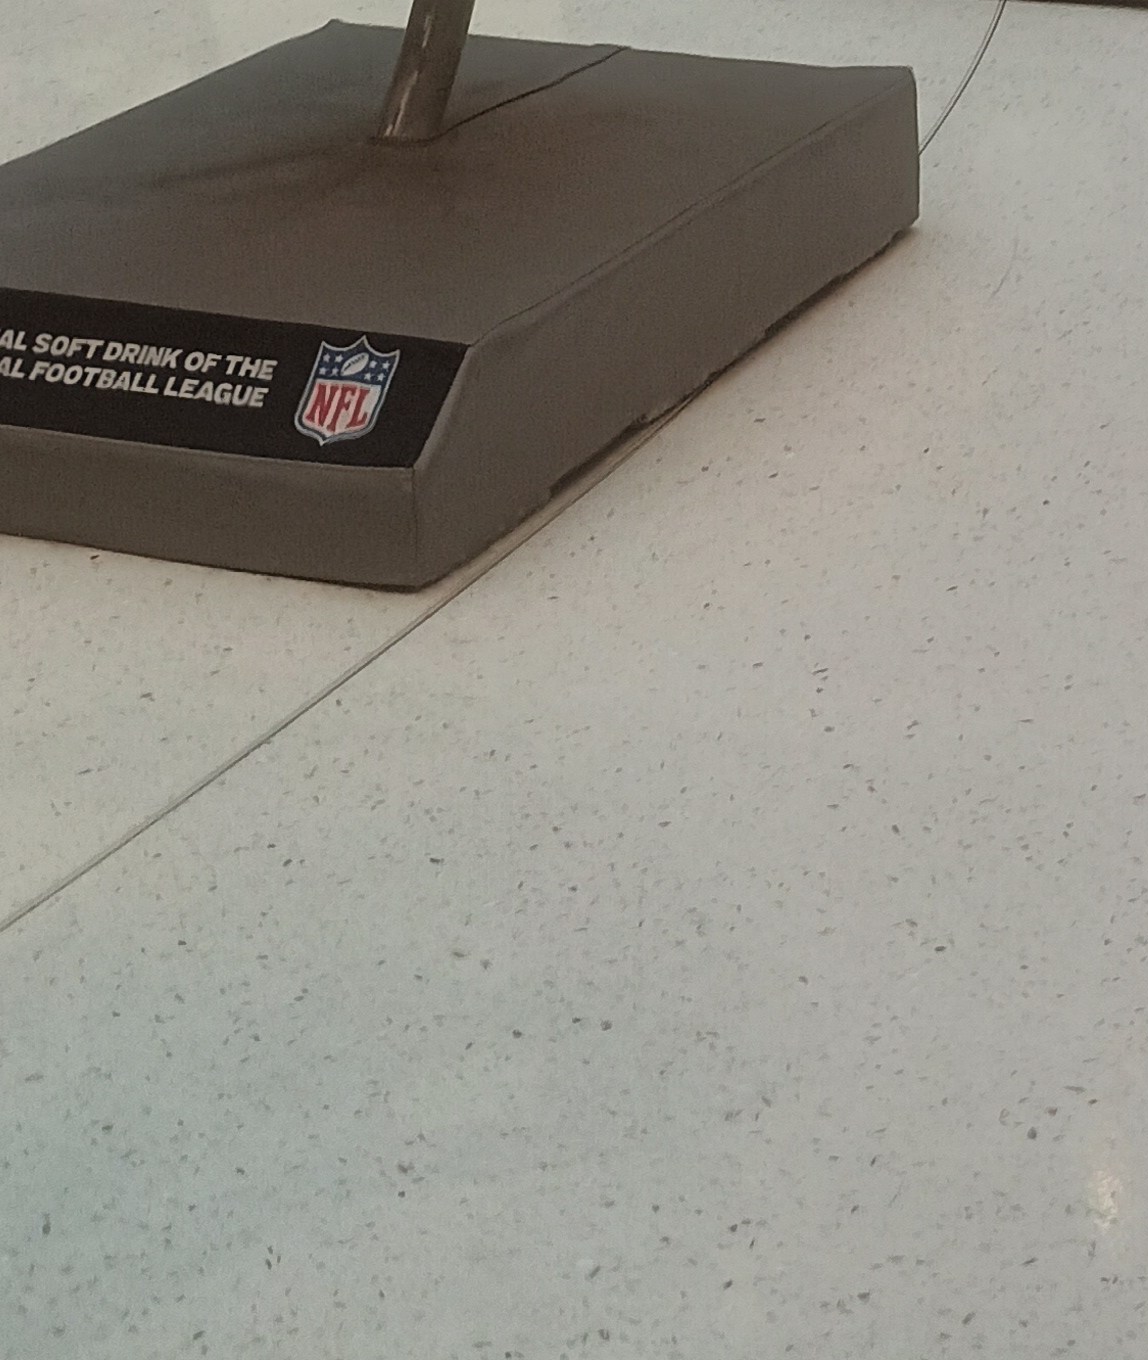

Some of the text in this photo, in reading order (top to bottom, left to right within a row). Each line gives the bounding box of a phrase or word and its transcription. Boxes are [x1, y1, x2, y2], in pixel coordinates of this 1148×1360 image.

[32, 333, 103, 360] SOFT
[103, 342, 183, 369] DRINK
[184, 352, 228, 374] OF
[226, 355, 278, 380] THE
[29, 362, 160, 394] FOOTBALL
[163, 379, 269, 408] LEAGUE
[306, 382, 372, 433] NFL
